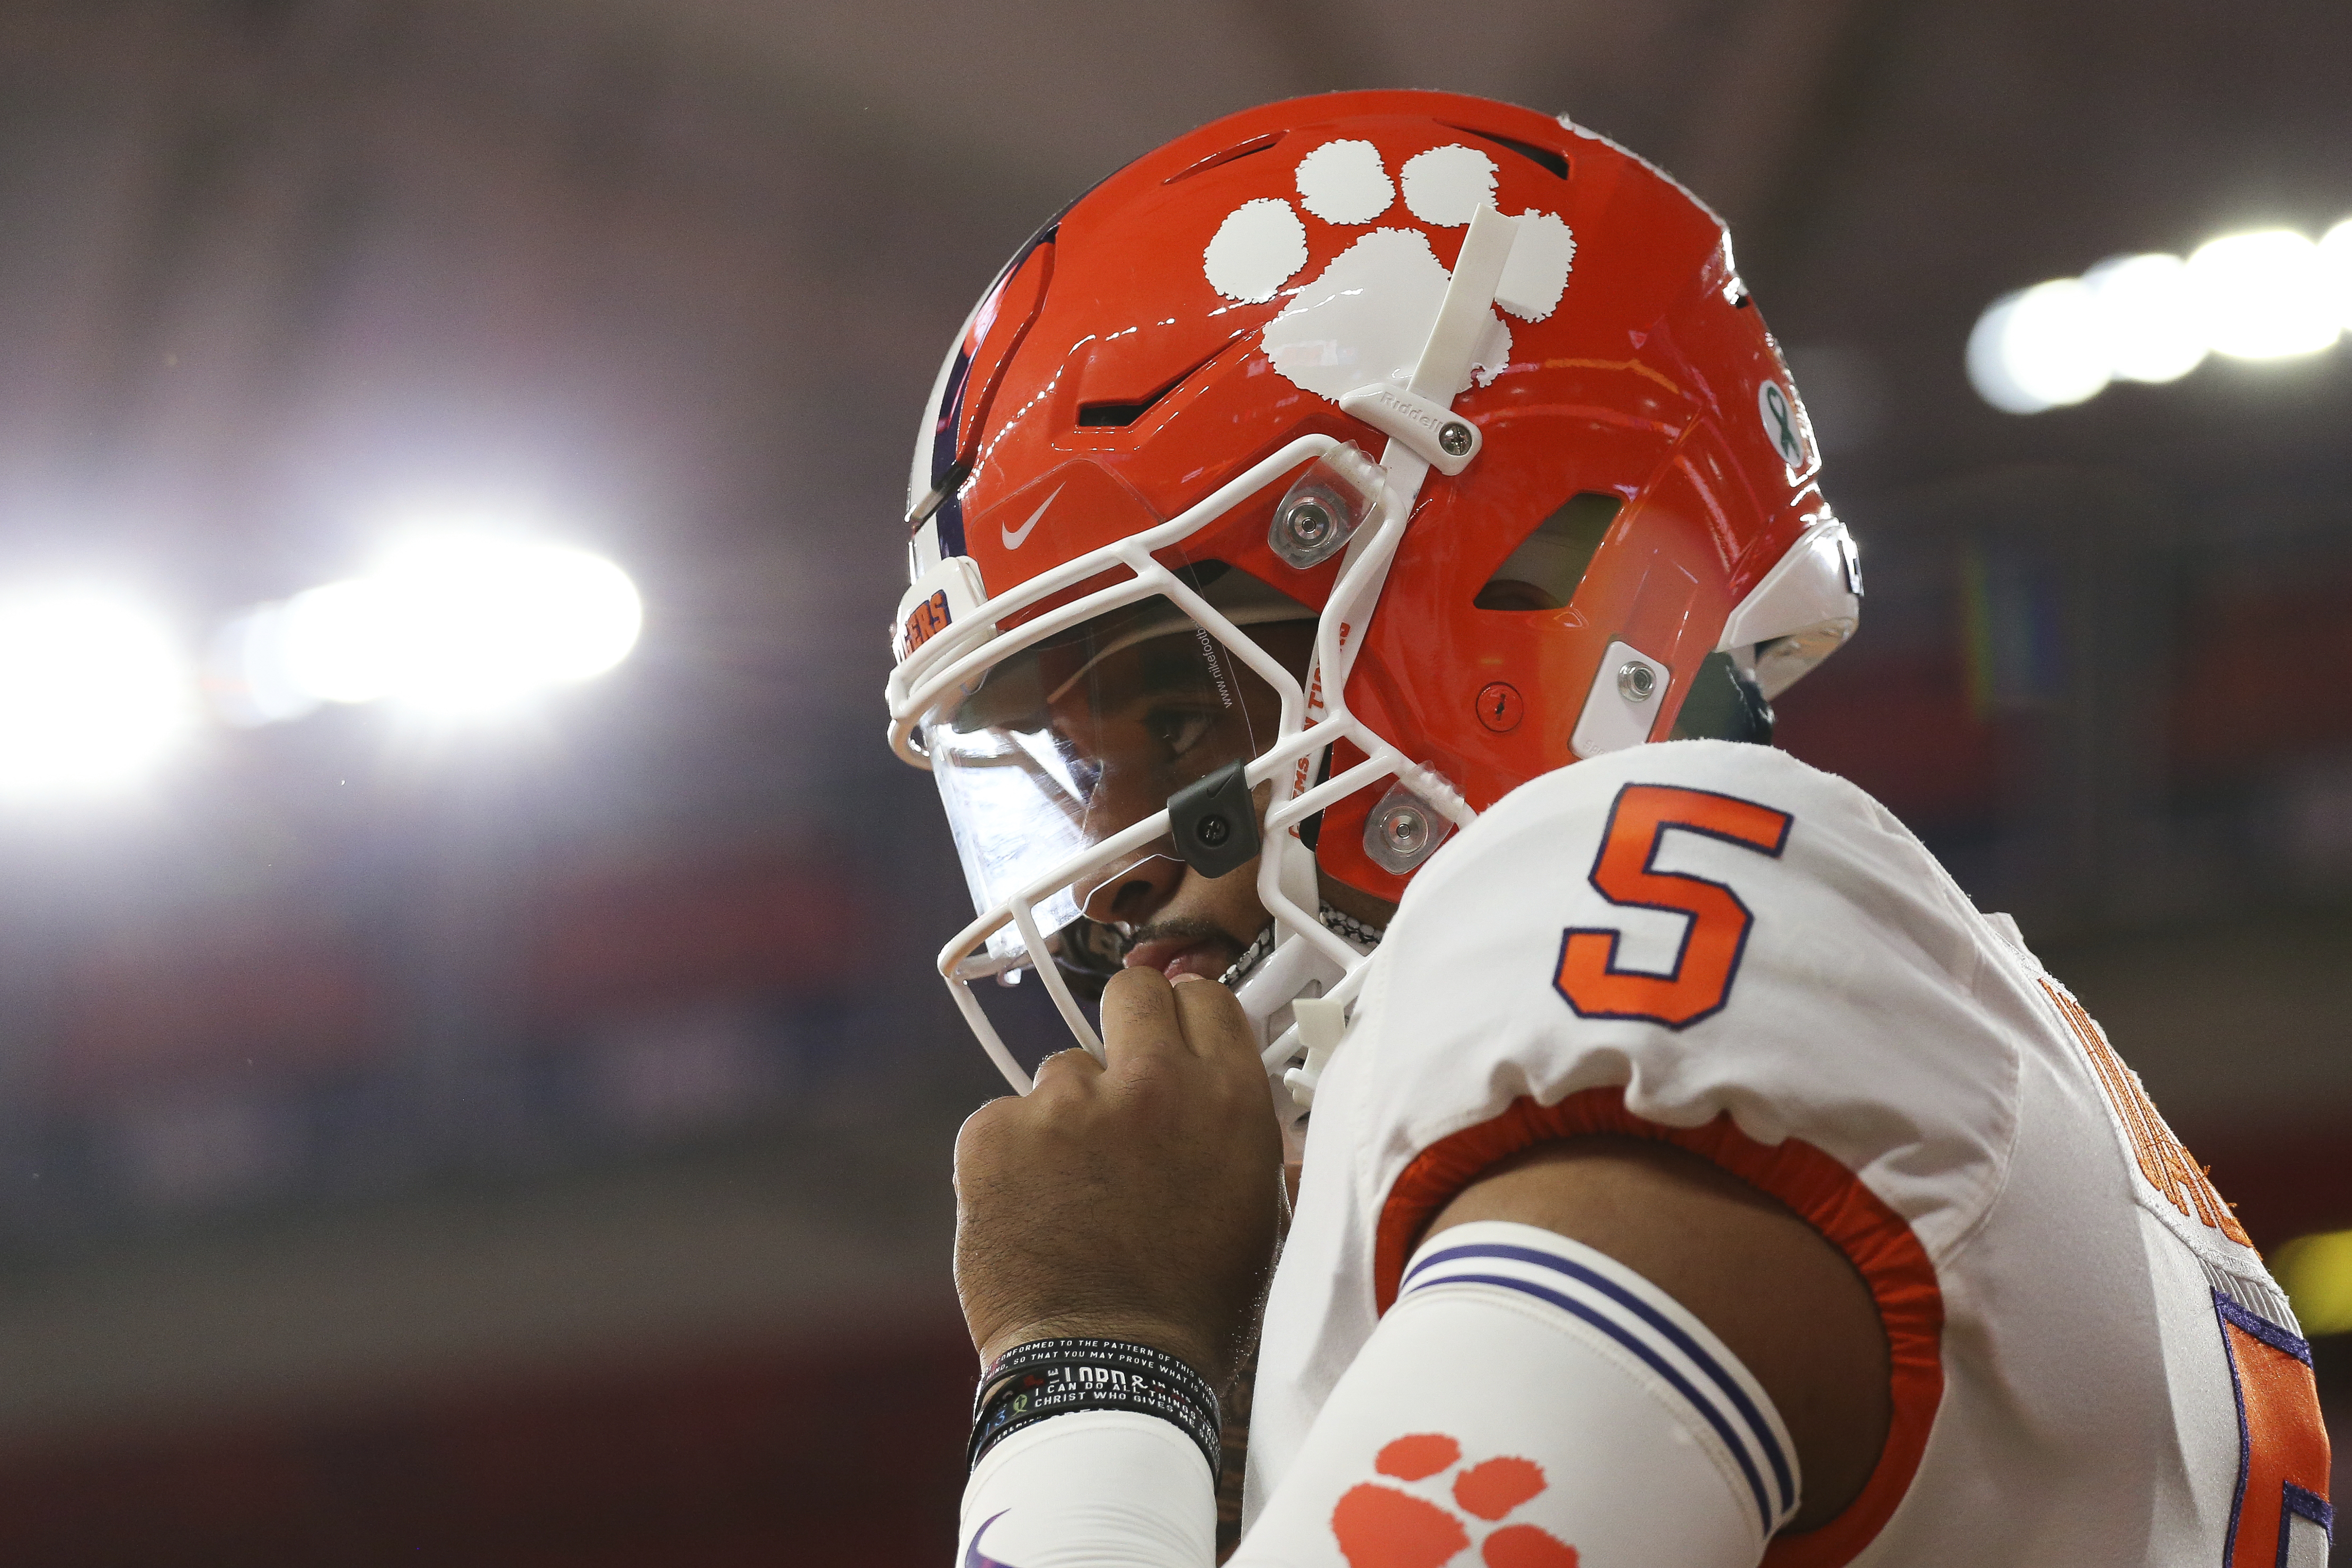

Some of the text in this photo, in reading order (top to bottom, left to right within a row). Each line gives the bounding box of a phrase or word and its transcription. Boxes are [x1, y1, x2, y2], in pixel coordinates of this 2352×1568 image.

[1380, 391, 1444, 432] Riddell
[904, 589, 953, 659] ERS
[1552, 781, 1795, 1032] 5
[995, 1341, 1054, 1365] CONFORMED
[1103, 1341, 1154, 1357] PATTERN
[1159, 1353, 1171, 1362] OF
[1175, 1360, 1195, 1377] THIS
[1013, 1357, 1025, 1365] SO
[1031, 1351, 1058, 1360] THAT
[1119, 1354, 1154, 1368] PROVE
[1160, 1365, 1188, 1384] WHAT
[1191, 1383, 1198, 1392] IS
[1034, 1392, 1086, 1407] CHRIST
[1093, 1391, 1126, 1400] WHO
[1134, 1395, 1173, 1412] GIVES
[1179, 1411, 1195, 1428] ME
[1035, 1388, 1039, 1397] I
[1047, 1383, 1076, 1394] CAN
[1112, 1384, 1140, 1394] ALL
[1149, 1390, 1196, 1420] THINGS
